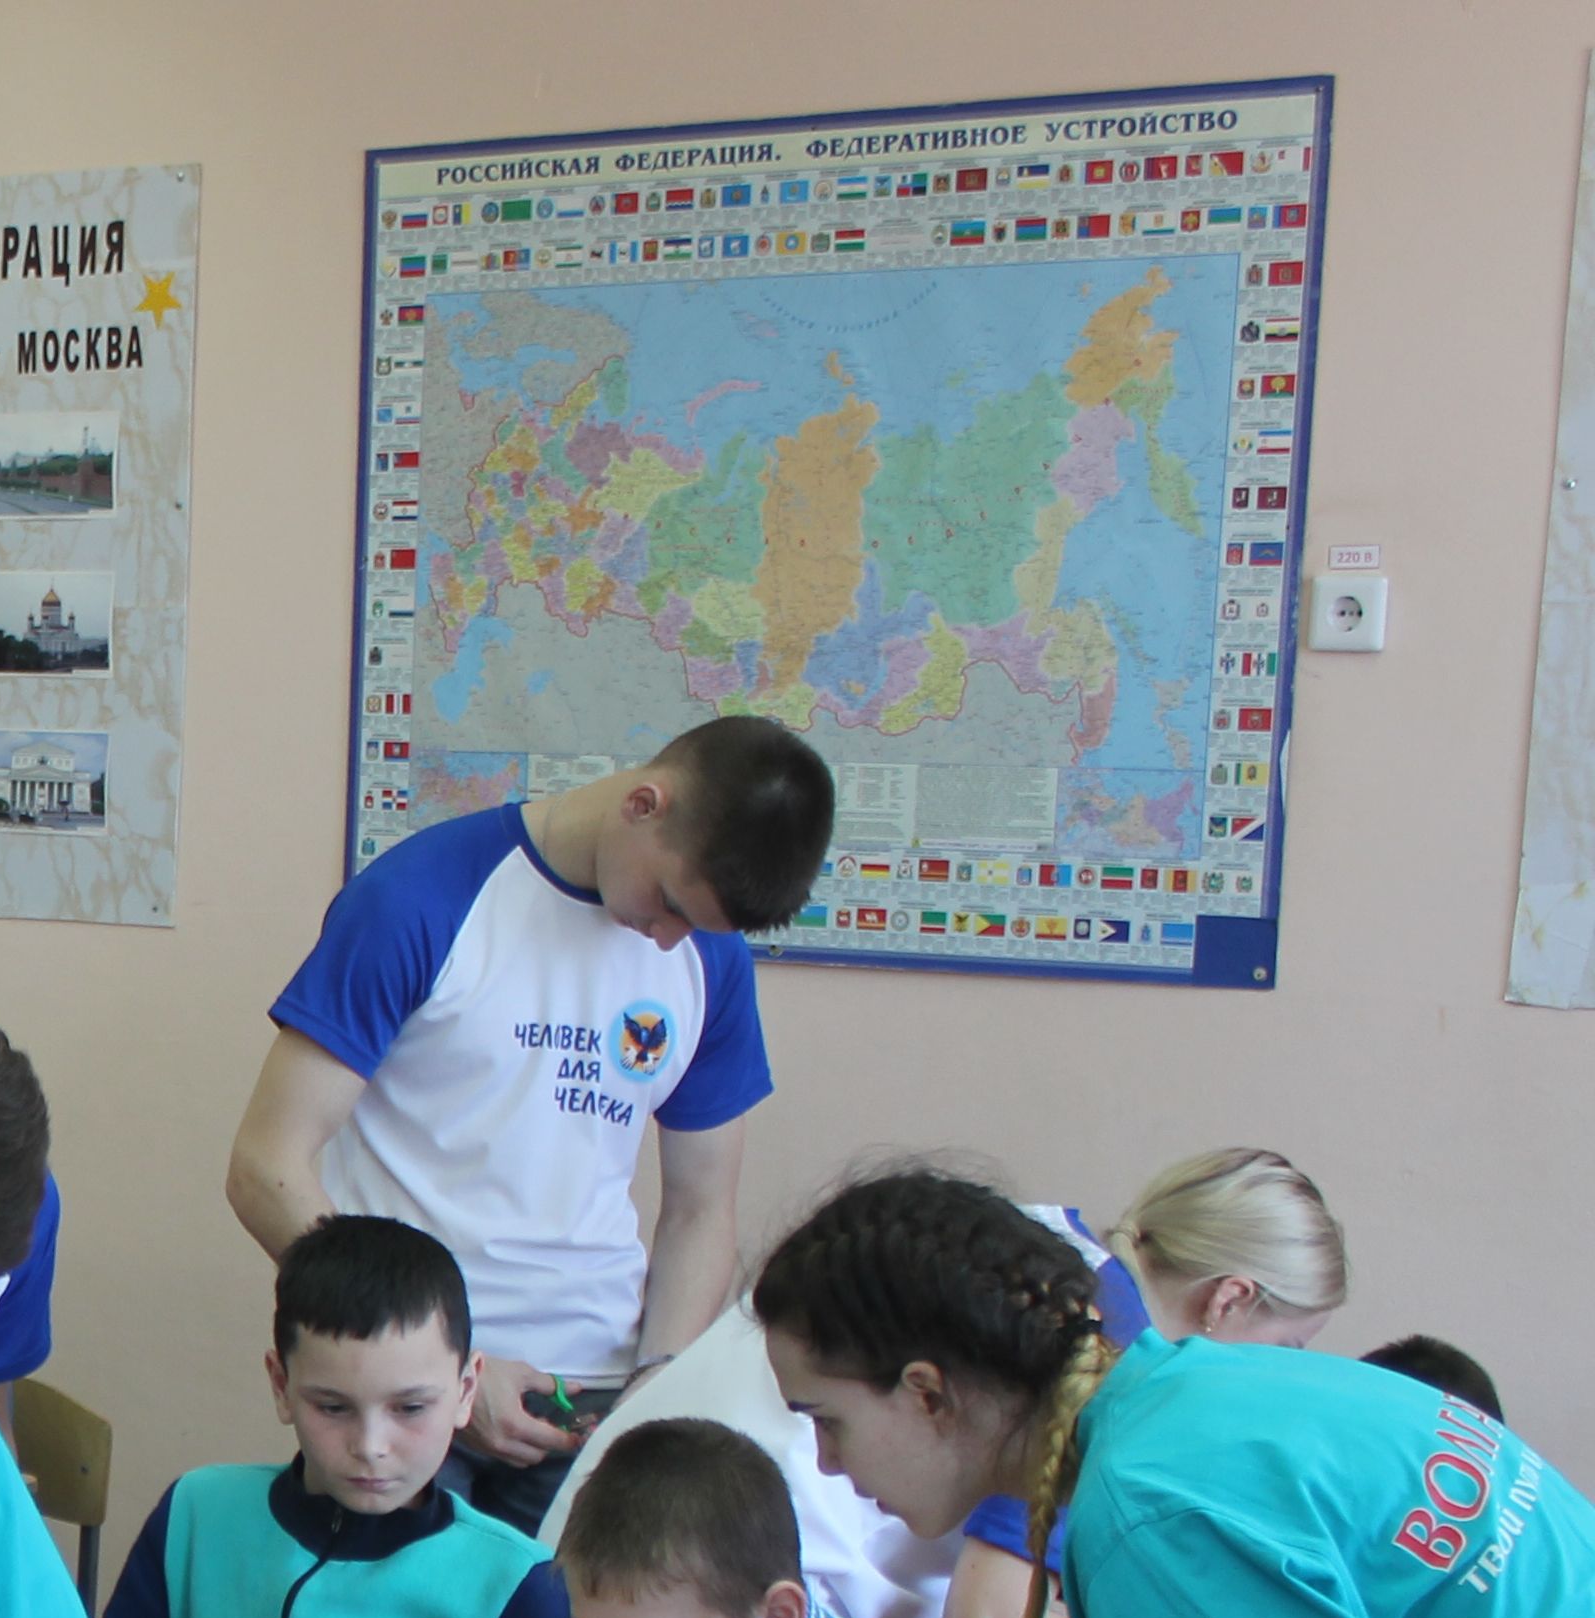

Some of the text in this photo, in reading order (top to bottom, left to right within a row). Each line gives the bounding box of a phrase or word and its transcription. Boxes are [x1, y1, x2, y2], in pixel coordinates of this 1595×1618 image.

[436, 107, 1239, 186] РОССИЙСКАЯ ФЕДЕРАЦИЯ. ФЕДЕРАТИВНОЕ УСТРОЙСТВО
[17, 325, 145, 375] МОСКВА
[1336, 551, 1360, 564] 220
[557, 1057, 601, 1083] ДЛЯ
